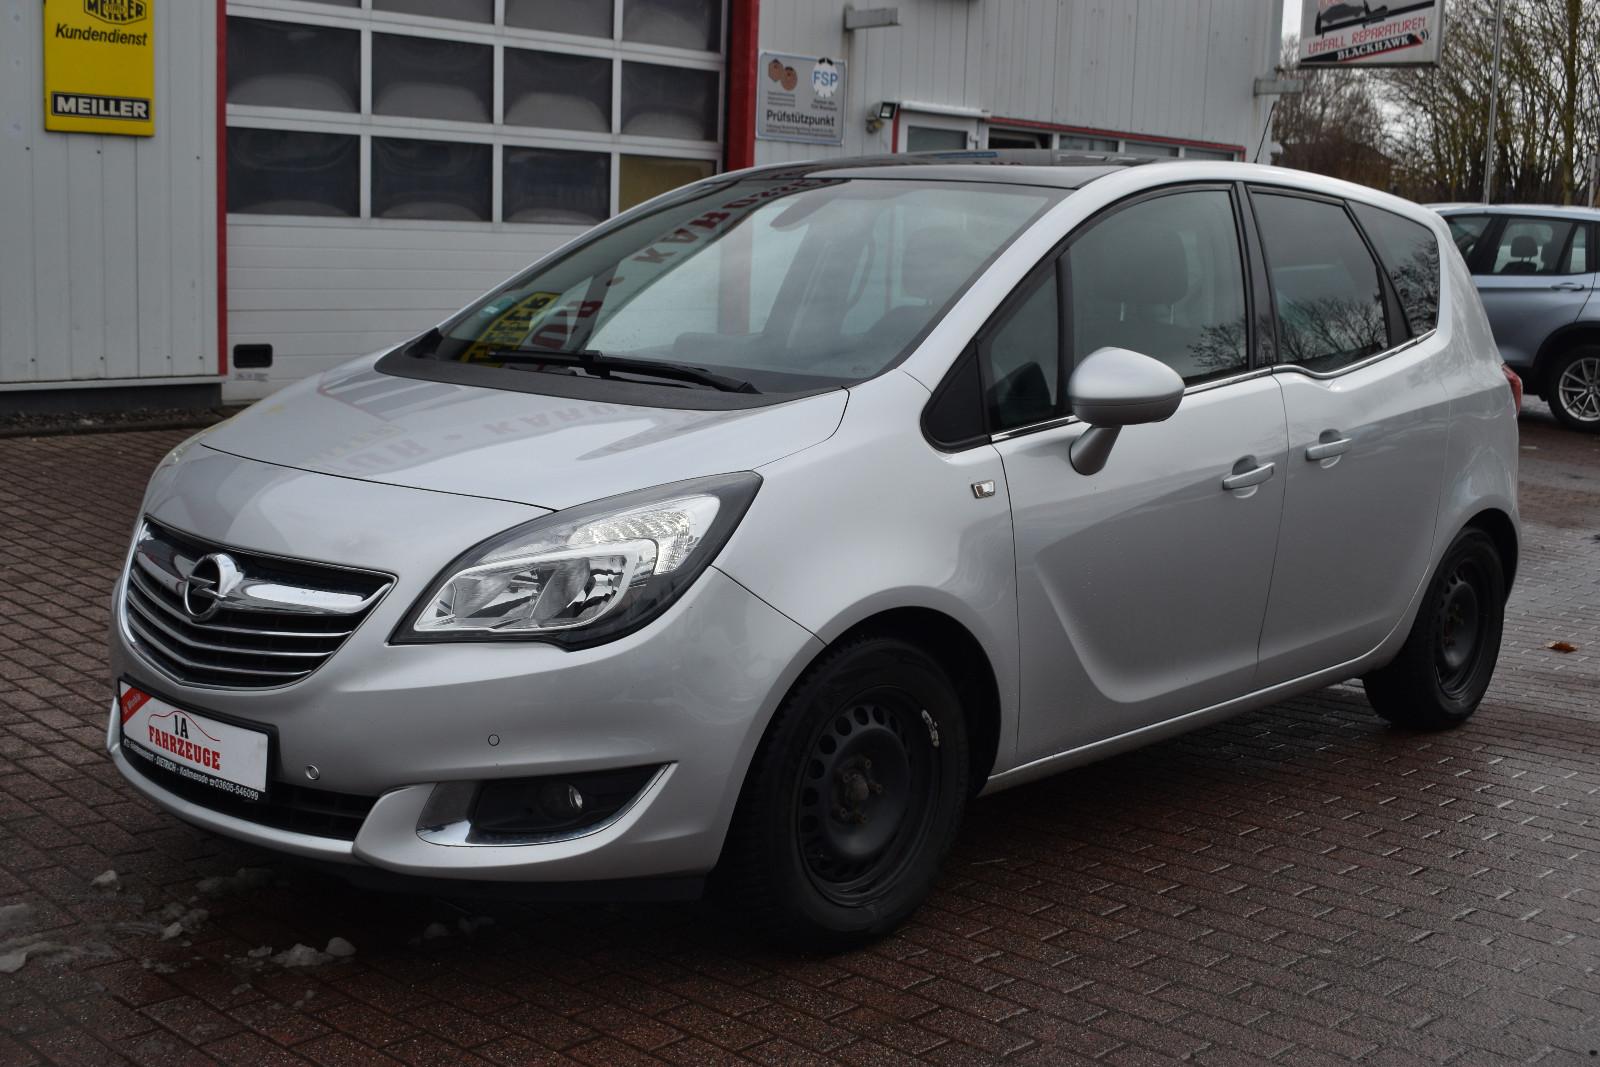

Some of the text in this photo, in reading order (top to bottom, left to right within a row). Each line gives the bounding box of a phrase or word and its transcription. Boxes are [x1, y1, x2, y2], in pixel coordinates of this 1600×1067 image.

[55, 23, 147, 46] Kundendienst
[1337, 34, 1410, 60] BLACKHAWK
[813, 71, 839, 87] FSP
[57, 96, 147, 118] MEILLER
[766, 109, 835, 127] Prüfstützpunkt
[148, 725, 221, 771] FAHRZEUGE
